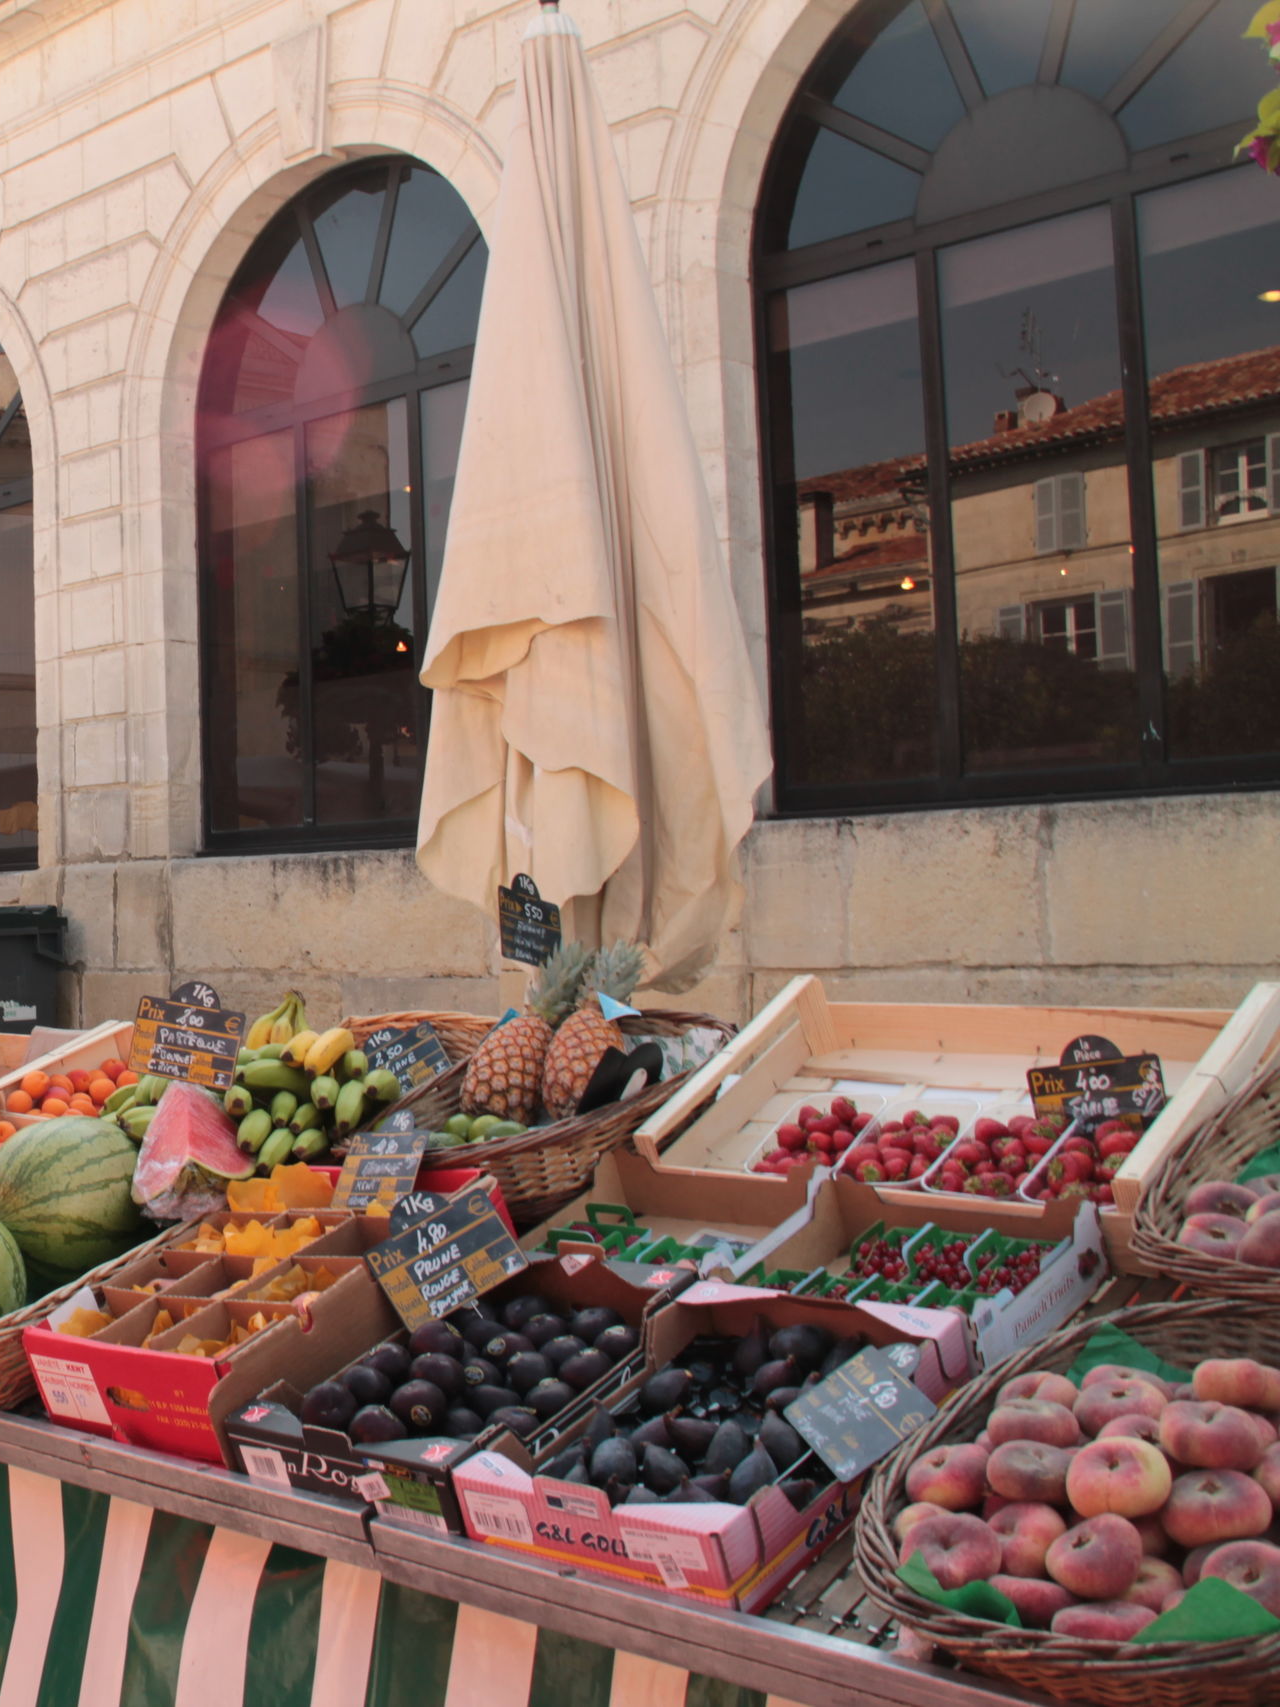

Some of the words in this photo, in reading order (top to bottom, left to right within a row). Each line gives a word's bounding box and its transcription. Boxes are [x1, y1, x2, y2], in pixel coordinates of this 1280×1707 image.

[518, 876, 535, 895] 1Kg
[193, 984, 215, 1008] 1Kg
[139, 998, 166, 1020] Prix
[368, 1030, 392, 1048] 1Kg
[1030, 1071, 1066, 1095] Prix
[401, 1193, 435, 1215] 1Kg
[367, 1248, 406, 1275] Prix
[413, 1243, 461, 1282] PRUNE
[420, 1267, 461, 1301] ROUGE
[535, 1521, 576, 1545] G&L
